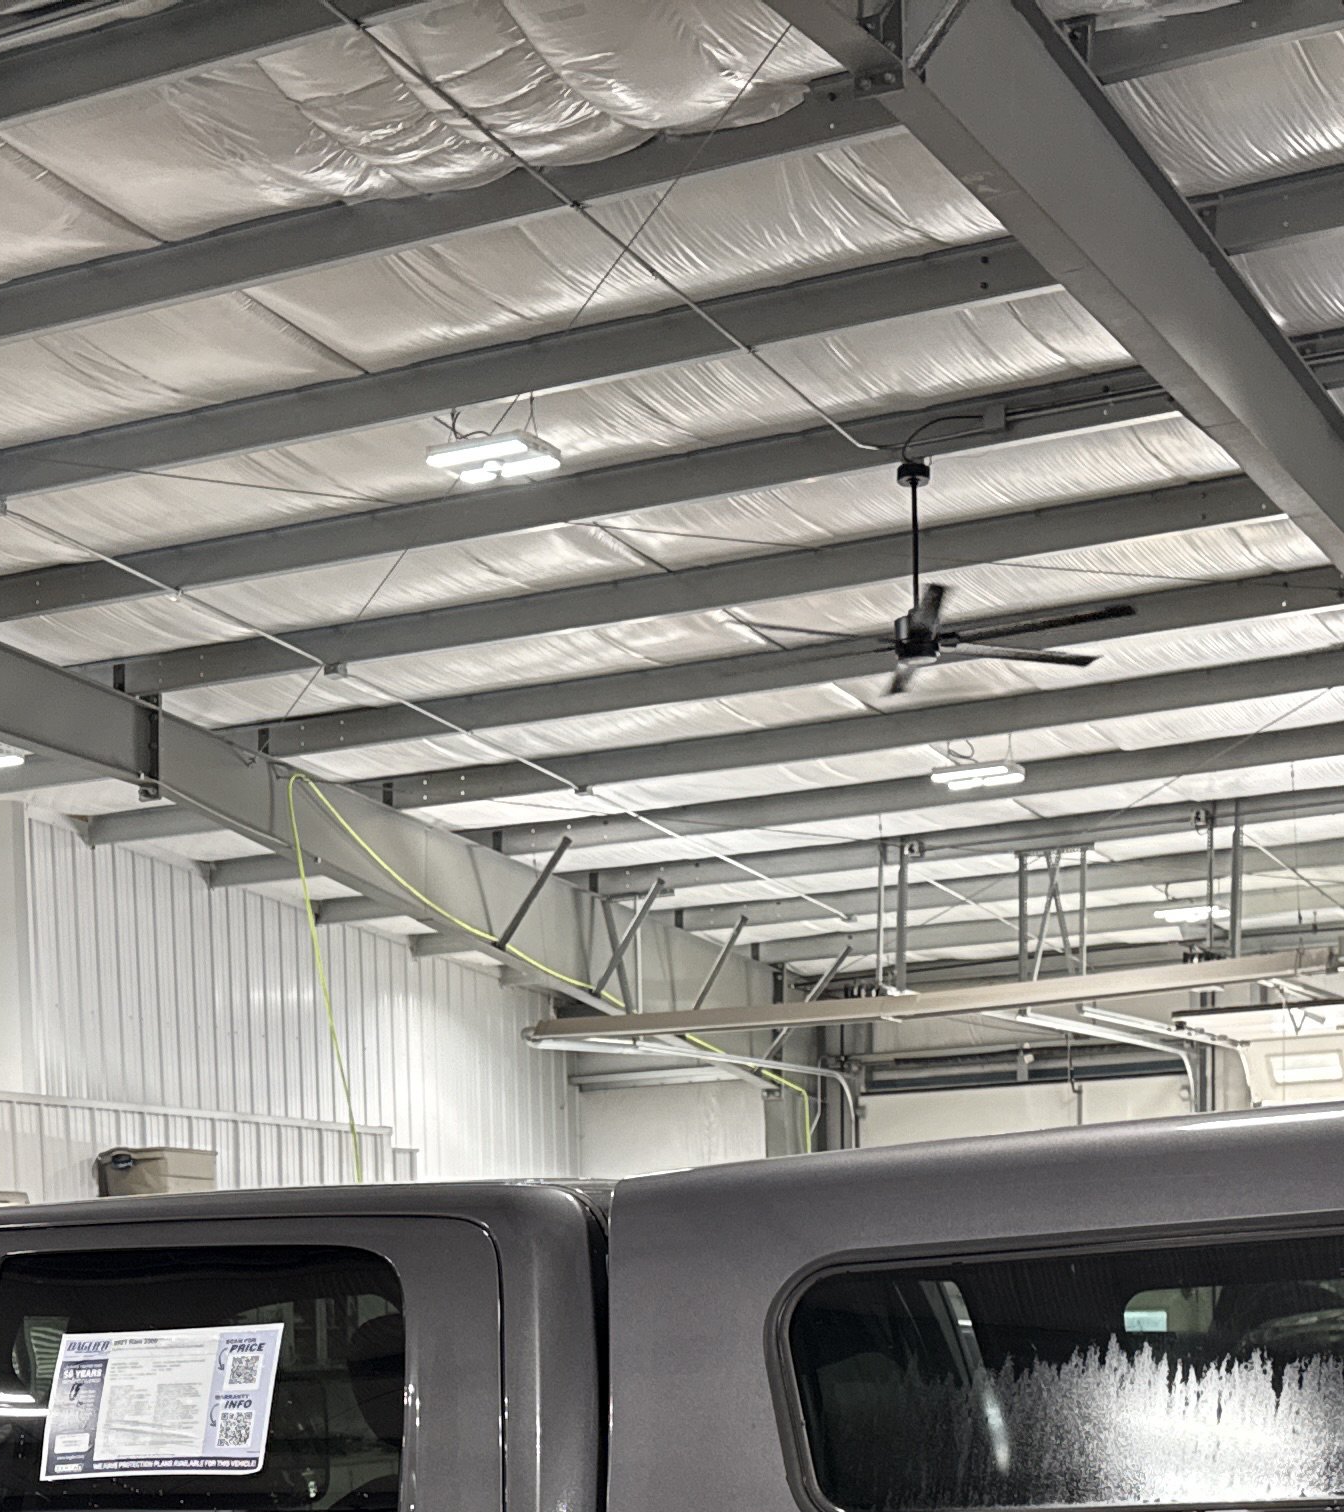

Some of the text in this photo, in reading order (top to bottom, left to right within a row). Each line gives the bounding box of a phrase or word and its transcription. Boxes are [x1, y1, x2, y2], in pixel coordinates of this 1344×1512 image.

[230, 1343, 265, 1352] PRICE
[75, 1368, 102, 1378] YEARS
[224, 1400, 253, 1409] INFO
